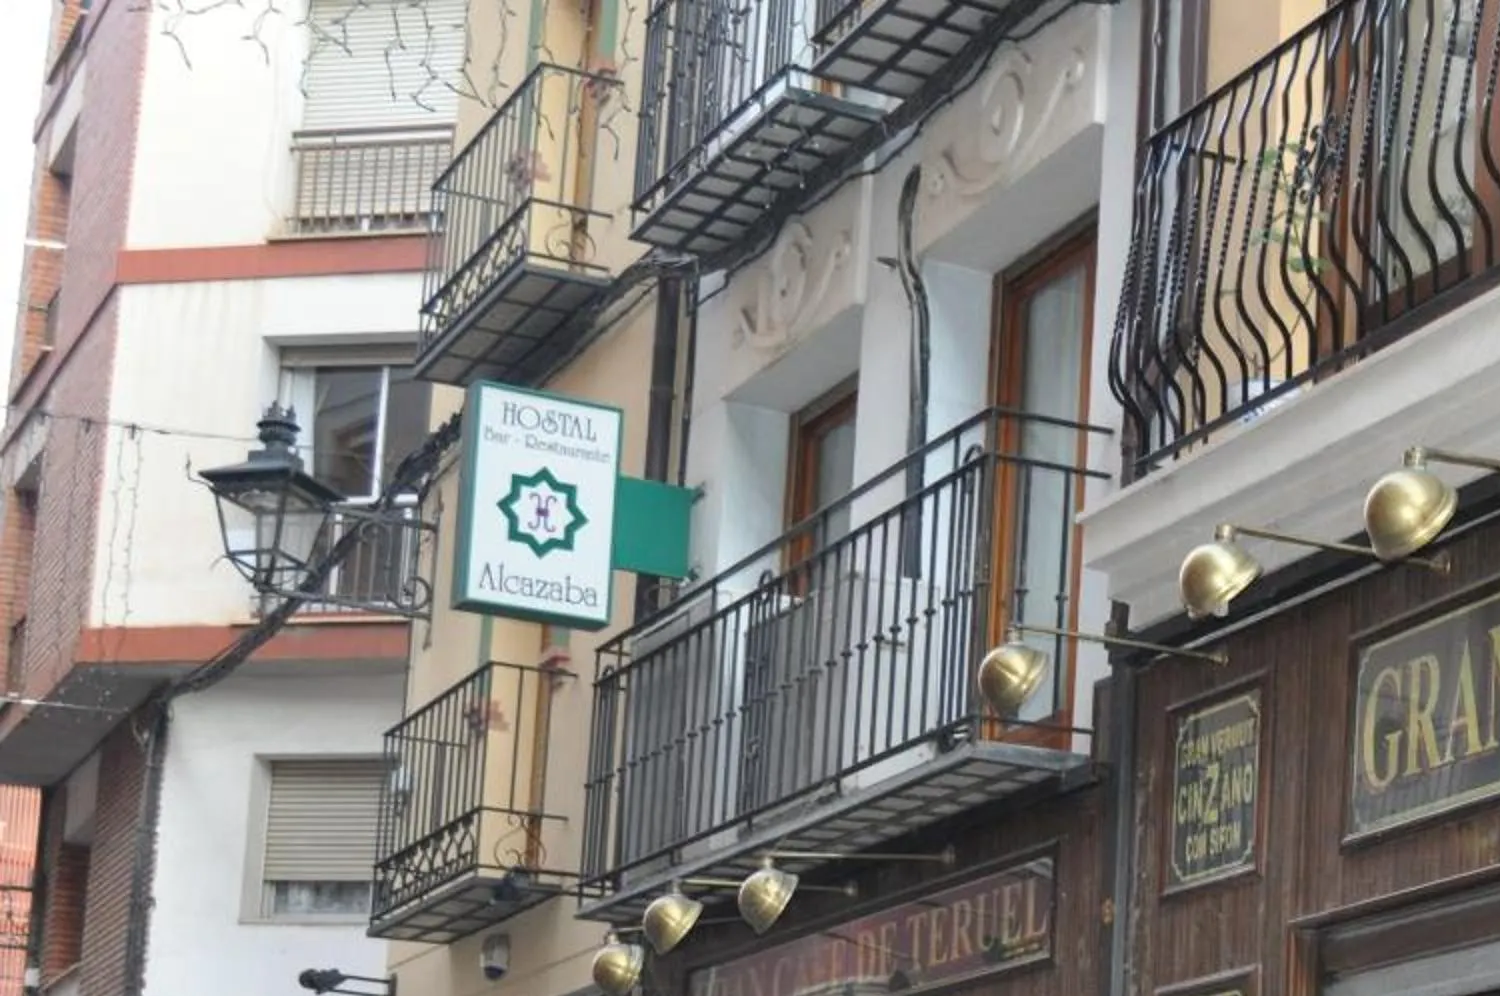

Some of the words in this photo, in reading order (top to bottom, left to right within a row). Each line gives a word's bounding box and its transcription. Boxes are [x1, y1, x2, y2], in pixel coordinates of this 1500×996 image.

[482, 426, 509, 445] Bar
[501, 401, 598, 443] HOSTAL
[478, 561, 598, 609] Alcazaba
[1177, 761, 1253, 825] CINZANO
[905, 876, 1048, 975] TERUEL
